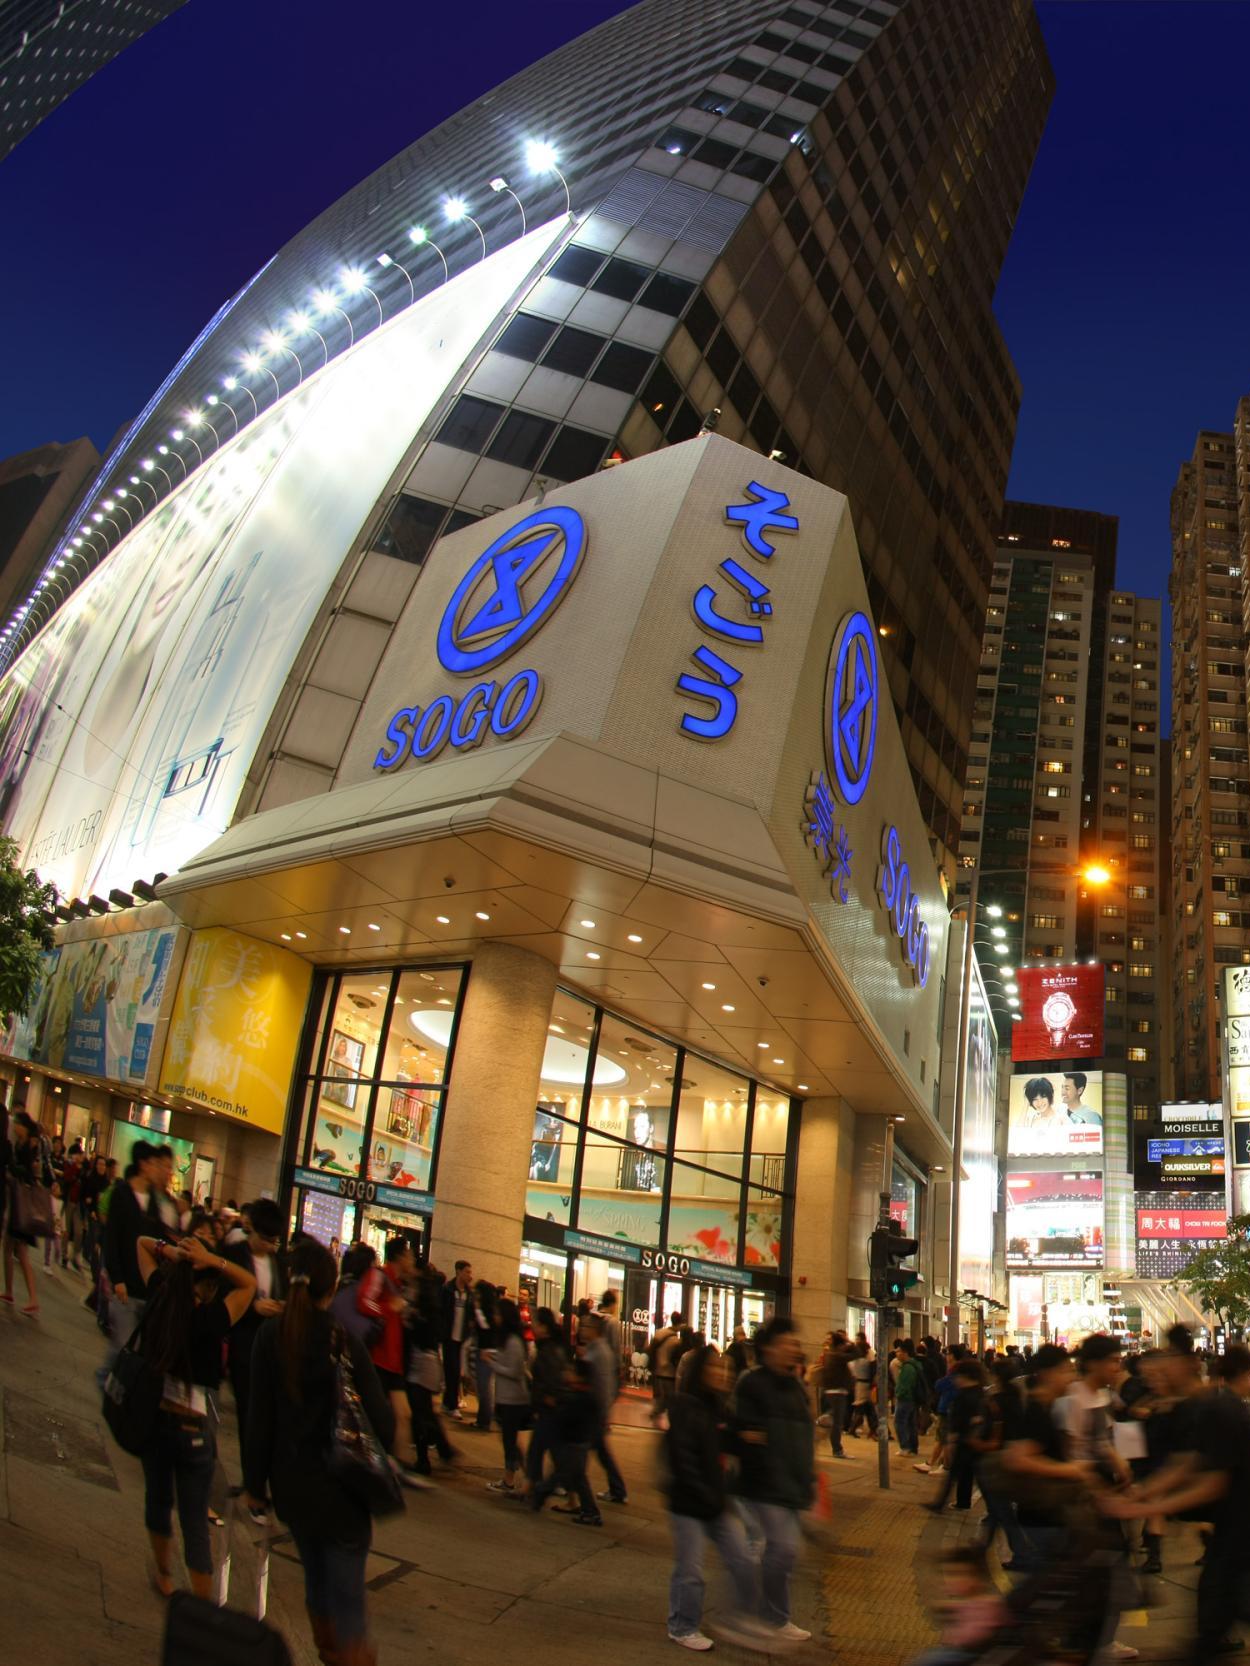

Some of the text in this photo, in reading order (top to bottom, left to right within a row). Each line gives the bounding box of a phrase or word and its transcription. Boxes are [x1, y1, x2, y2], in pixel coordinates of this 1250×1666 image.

[675, 480, 799, 740] そごう
[373, 668, 541, 771] SOGO
[876, 824, 931, 990] SOGO
[1041, 976, 1078, 985] ZENITH
[1164, 1123, 1219, 1134] MOISELLE
[1164, 1162, 1211, 1172] QUIKSILVER
[338, 1177, 376, 1202] SOGO
[1141, 1217, 1181, 1230] 周大福
[641, 1249, 690, 1275] SOGO
